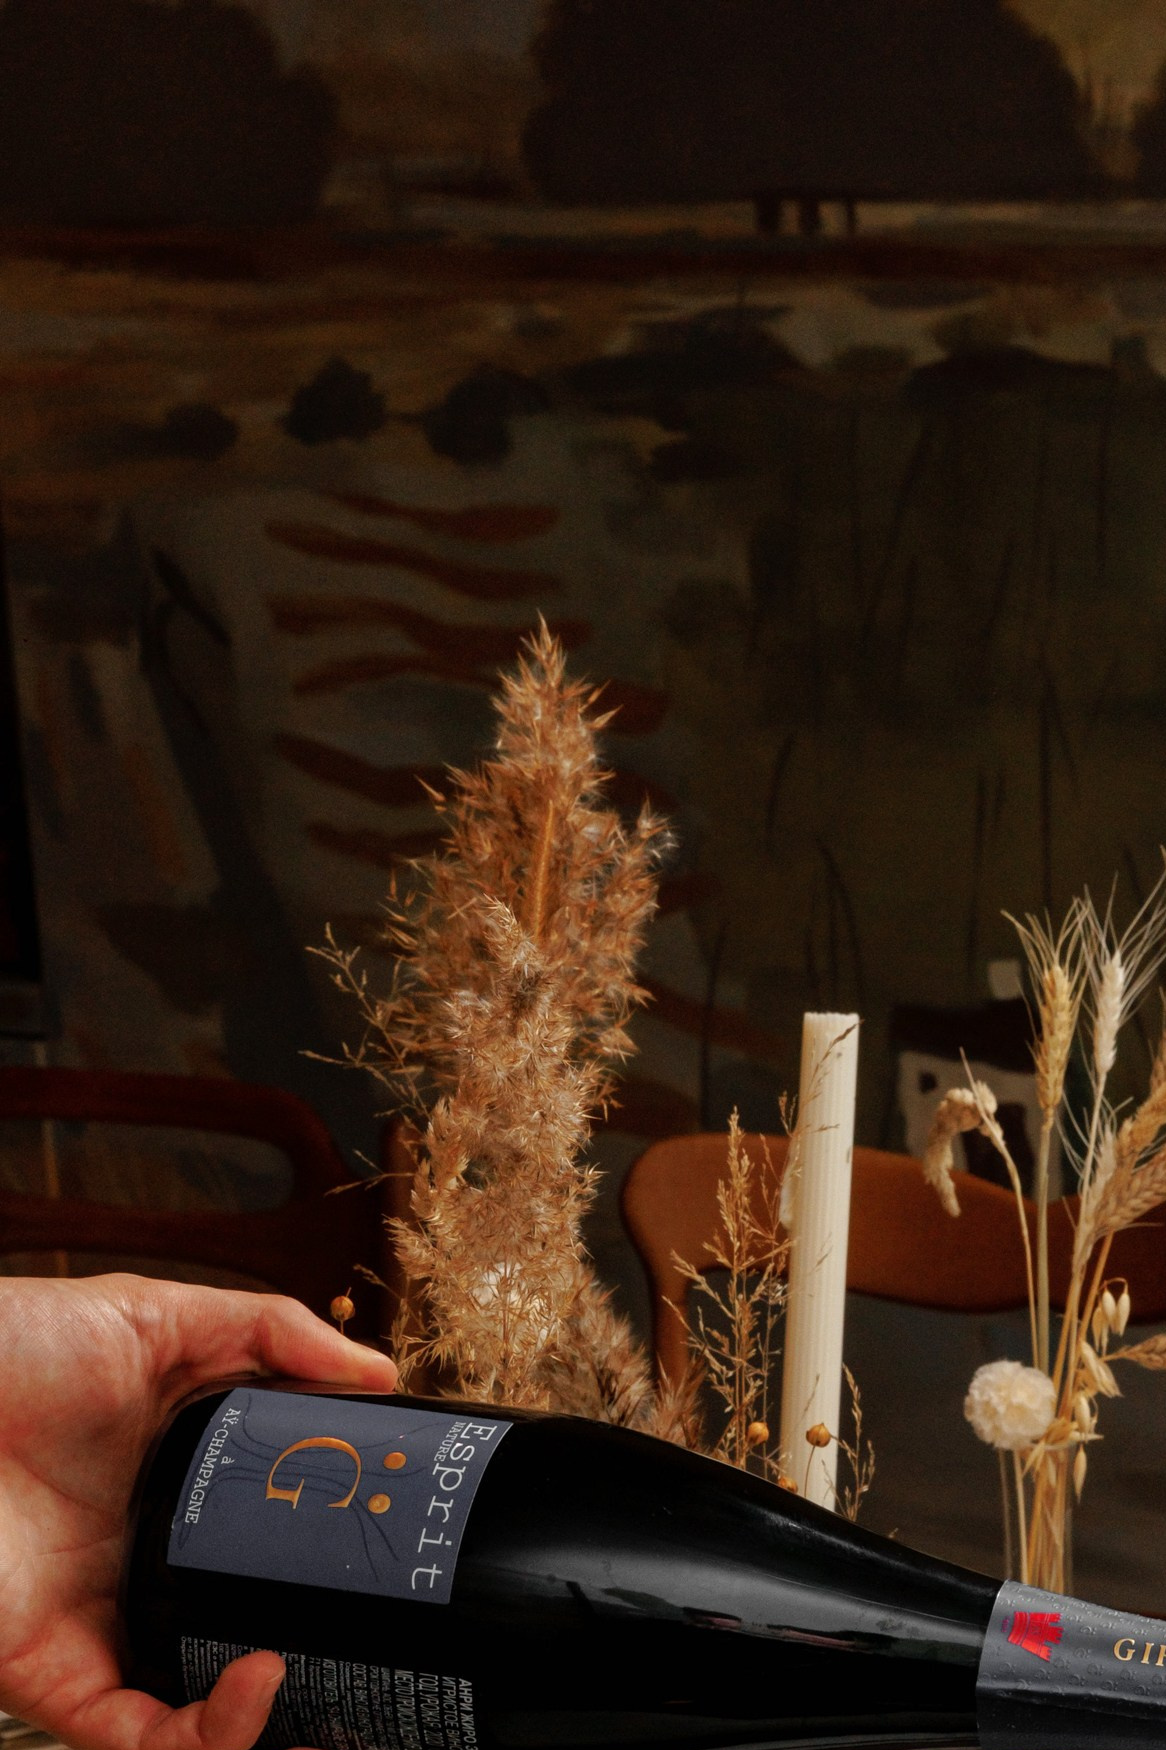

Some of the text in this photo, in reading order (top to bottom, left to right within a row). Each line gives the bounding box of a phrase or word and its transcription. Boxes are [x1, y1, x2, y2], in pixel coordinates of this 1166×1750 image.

[433, 1421, 465, 1463] NATURE
[184, 1407, 241, 1525] AŸ-CHAMPAGNE
[265, 1436, 363, 1510] G
[411, 1421, 498, 1591] Esprit
[415, 1672, 439, 1691] ГОД
[441, 1675, 458, 1728] ИГРИСТОЕ
[458, 1678, 474, 1711] АНРИ
[460, 1712, 476, 1743] ЖИРО
